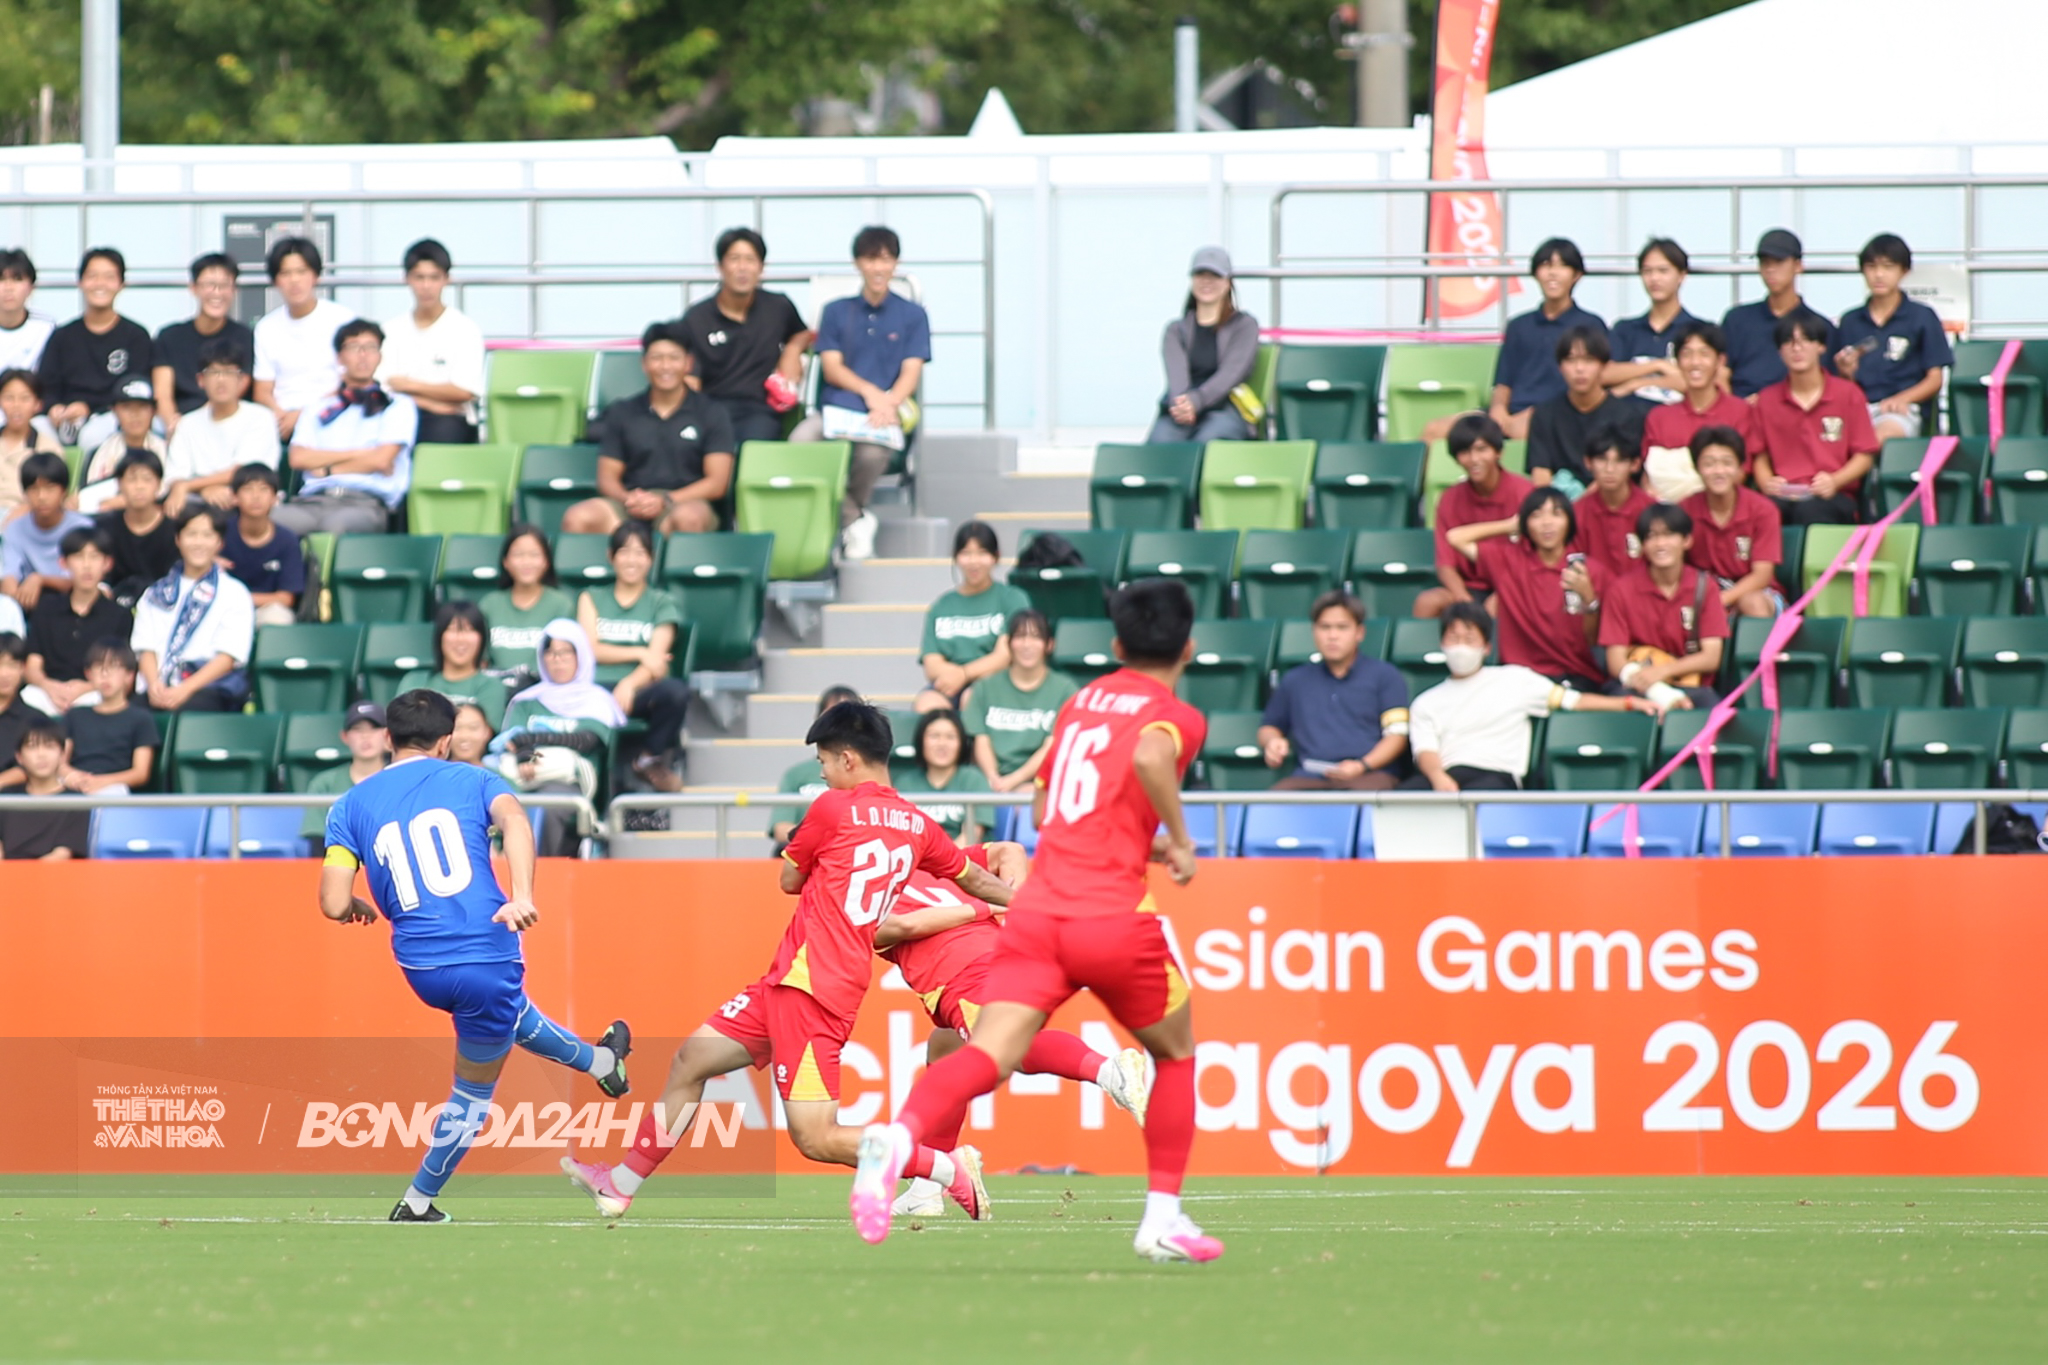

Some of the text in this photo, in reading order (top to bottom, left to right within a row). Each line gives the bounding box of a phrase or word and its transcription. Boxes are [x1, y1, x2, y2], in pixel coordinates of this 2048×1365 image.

[851, 805, 866, 826] L.
[868, 806, 882, 826] D.
[883, 807, 910, 831] LONG
[1043, 721, 1111, 825] 16
[374, 808, 473, 912] 10
[844, 838, 914, 927] 22
[1416, 915, 1760, 992] Games
[1642, 1019, 1980, 1132] 2026
